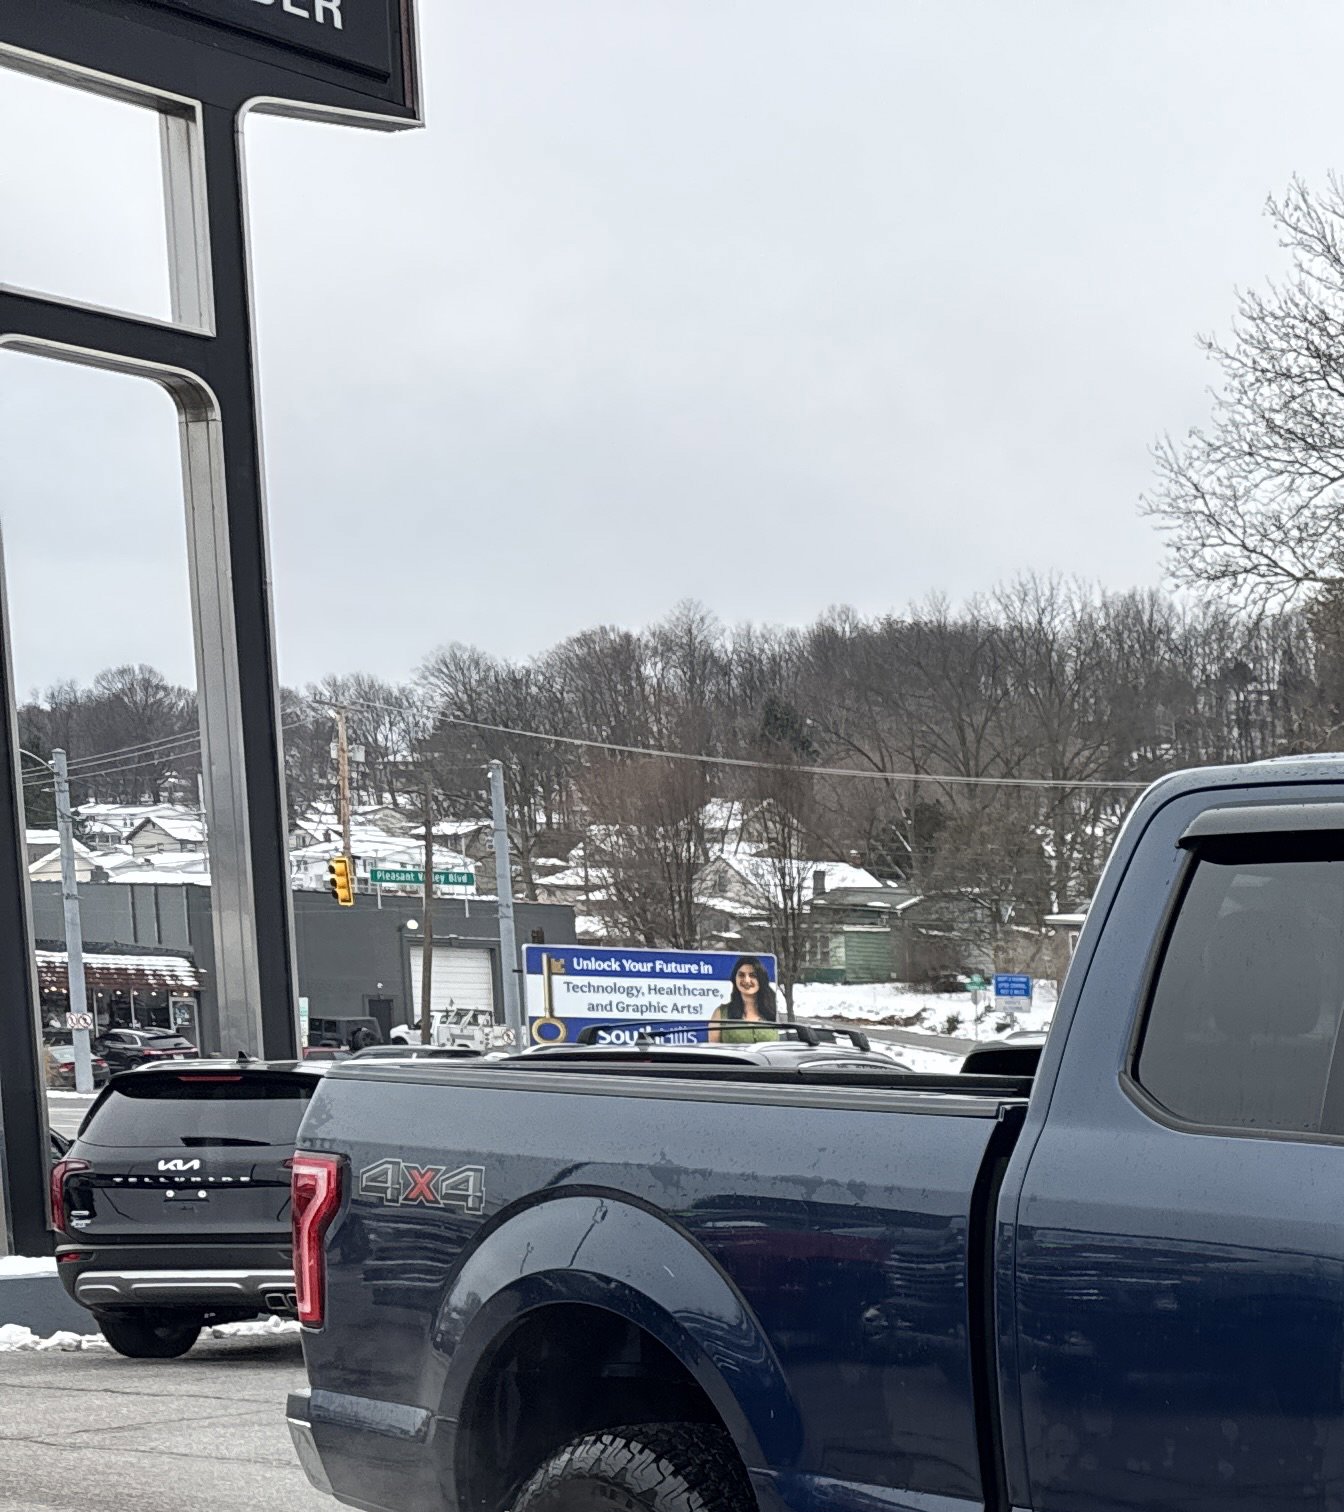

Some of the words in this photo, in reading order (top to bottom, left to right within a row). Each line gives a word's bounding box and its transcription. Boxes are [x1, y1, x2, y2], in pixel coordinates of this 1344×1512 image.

[376, 870, 415, 881] Pleasant
[417, 872, 445, 884] Vley
[448, 875, 468, 883] Blvd
[572, 957, 621, 972] Unlock
[622, 959, 652, 973] Your
[655, 960, 699, 974] Future
[700, 961, 713, 974] in
[563, 981, 645, 998] Technology,
[647, 983, 724, 999] Healthcare,
[587, 1000, 612, 1012] and
[615, 1001, 669, 1016] Graphic
[671, 1002, 703, 1015] Arts!
[158, 1159, 200, 1171] KIA
